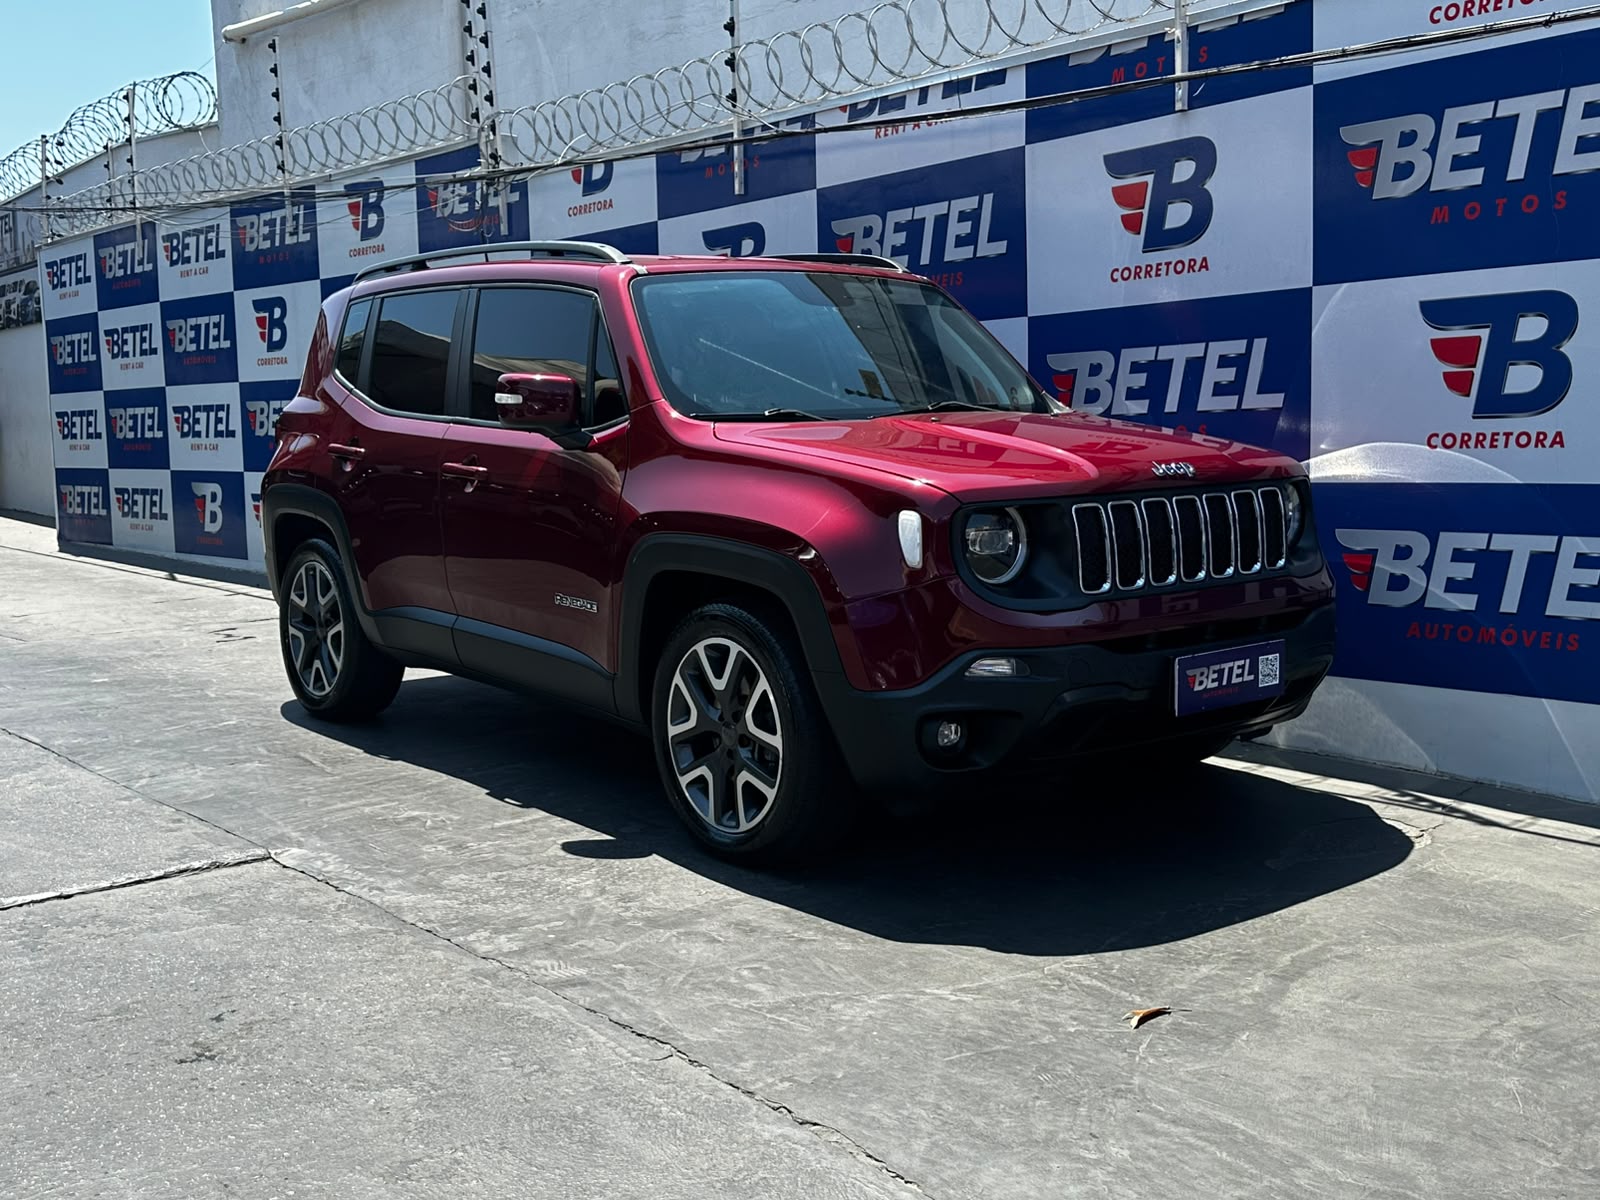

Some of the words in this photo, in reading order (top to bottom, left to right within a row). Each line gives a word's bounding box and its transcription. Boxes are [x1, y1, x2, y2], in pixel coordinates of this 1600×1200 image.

[1111, 46, 1208, 84] MOTS
[568, 198, 614, 218] CORRETORA
[1430, 191, 1568, 224] MOTOS
[161, 223, 226, 267] BETEL
[831, 192, 1008, 267] BETEL
[348, 243, 386, 258] CORRETORA
[45, 253, 92, 291] BETEL
[1110, 256, 1210, 282] CORRETORA
[50, 331, 97, 366] BETEL
[104, 323, 158, 360] BETEL
[166, 314, 231, 353] BETEL
[257, 356, 288, 367] CORRETORA
[1046, 337, 1286, 417] BETEL
[55, 409, 102, 441] BETEL
[109, 406, 164, 440] BETEL
[172, 403, 236, 439] BETEL
[1426, 430, 1566, 450] CORRETORA
[1152, 460, 1197, 478] Jeep
[60, 484, 107, 516] BETEL
[114, 487, 168, 521] BETEL
[1406, 620, 1581, 652] AUTOMÓVEIS
[1185, 658, 1254, 692] BETEL
